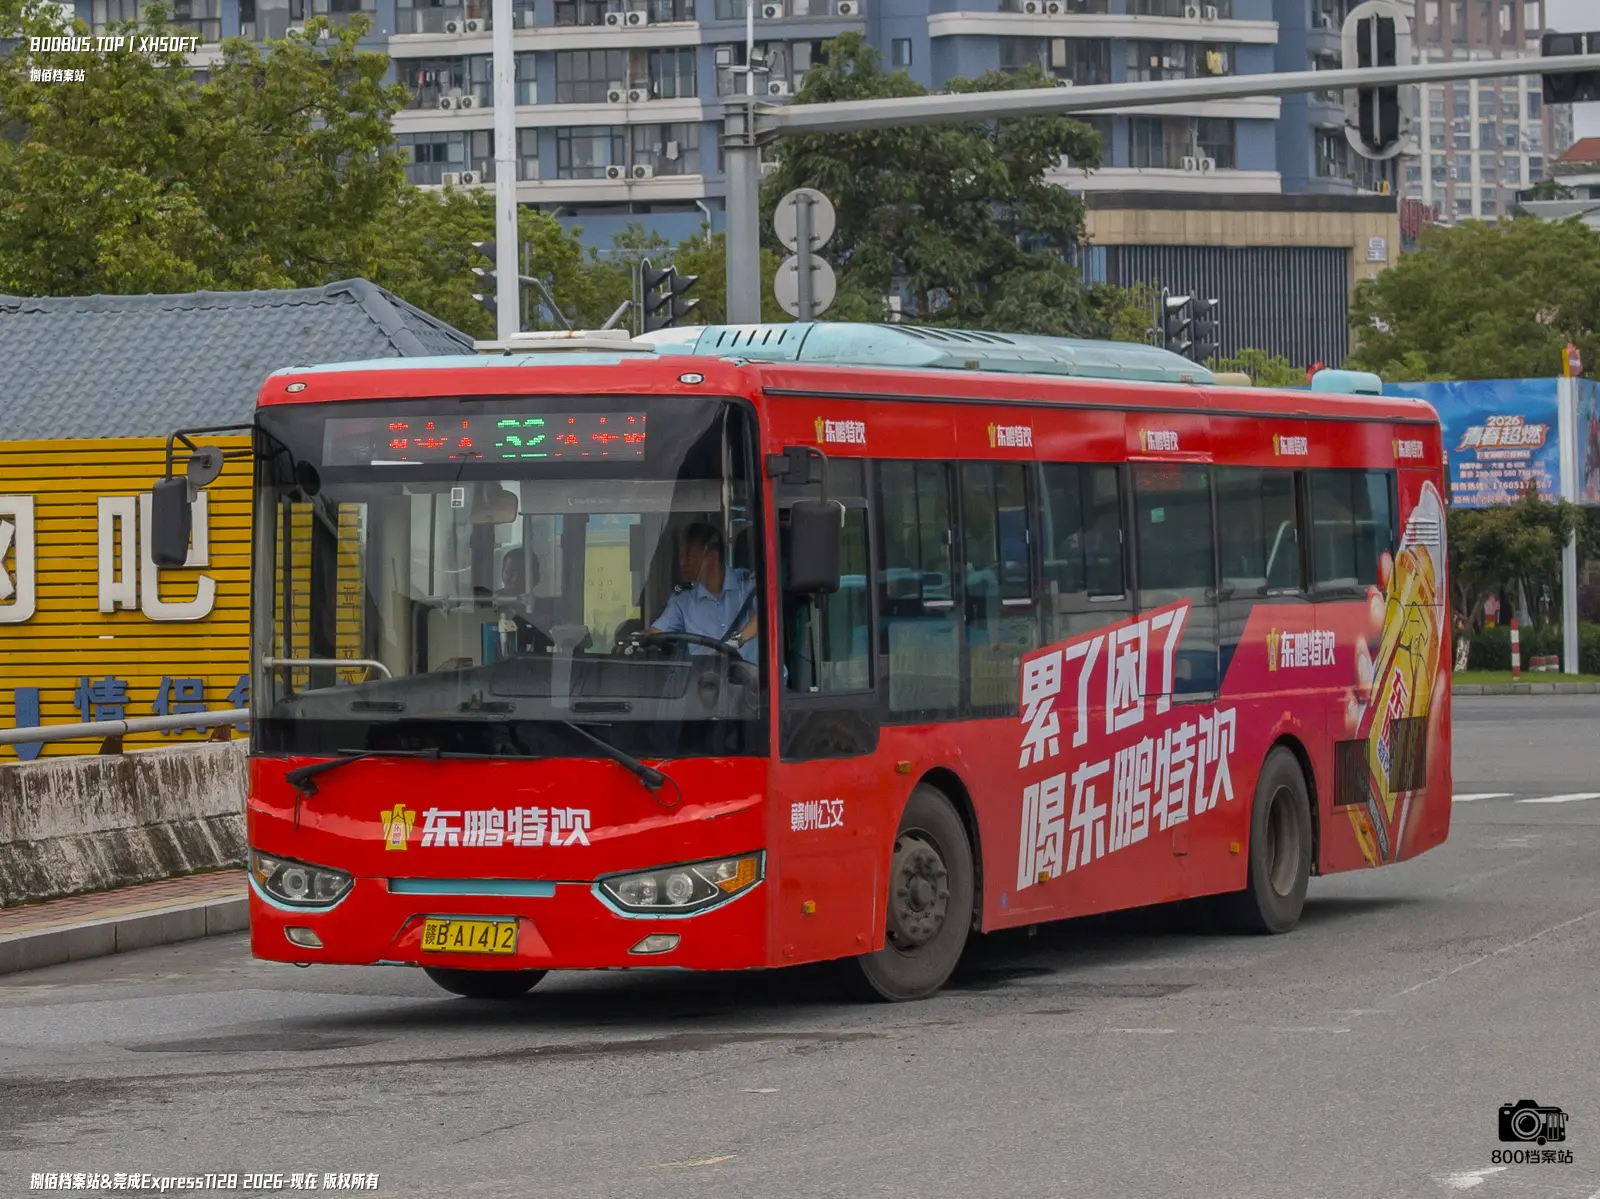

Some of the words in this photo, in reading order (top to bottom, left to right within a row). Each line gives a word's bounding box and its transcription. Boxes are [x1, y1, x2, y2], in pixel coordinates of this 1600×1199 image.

[825, 419, 866, 443] 东鹏特饮
[996, 424, 1033, 447] 东鹏特饮
[1281, 630, 1336, 668] 东鹏特饮
[1019, 605, 1189, 769] 累了困了
[791, 798, 844, 831] 赣州公交
[1017, 707, 1237, 891] 喝东鹏特饮
[421, 806, 591, 847] 东鹏特饮
